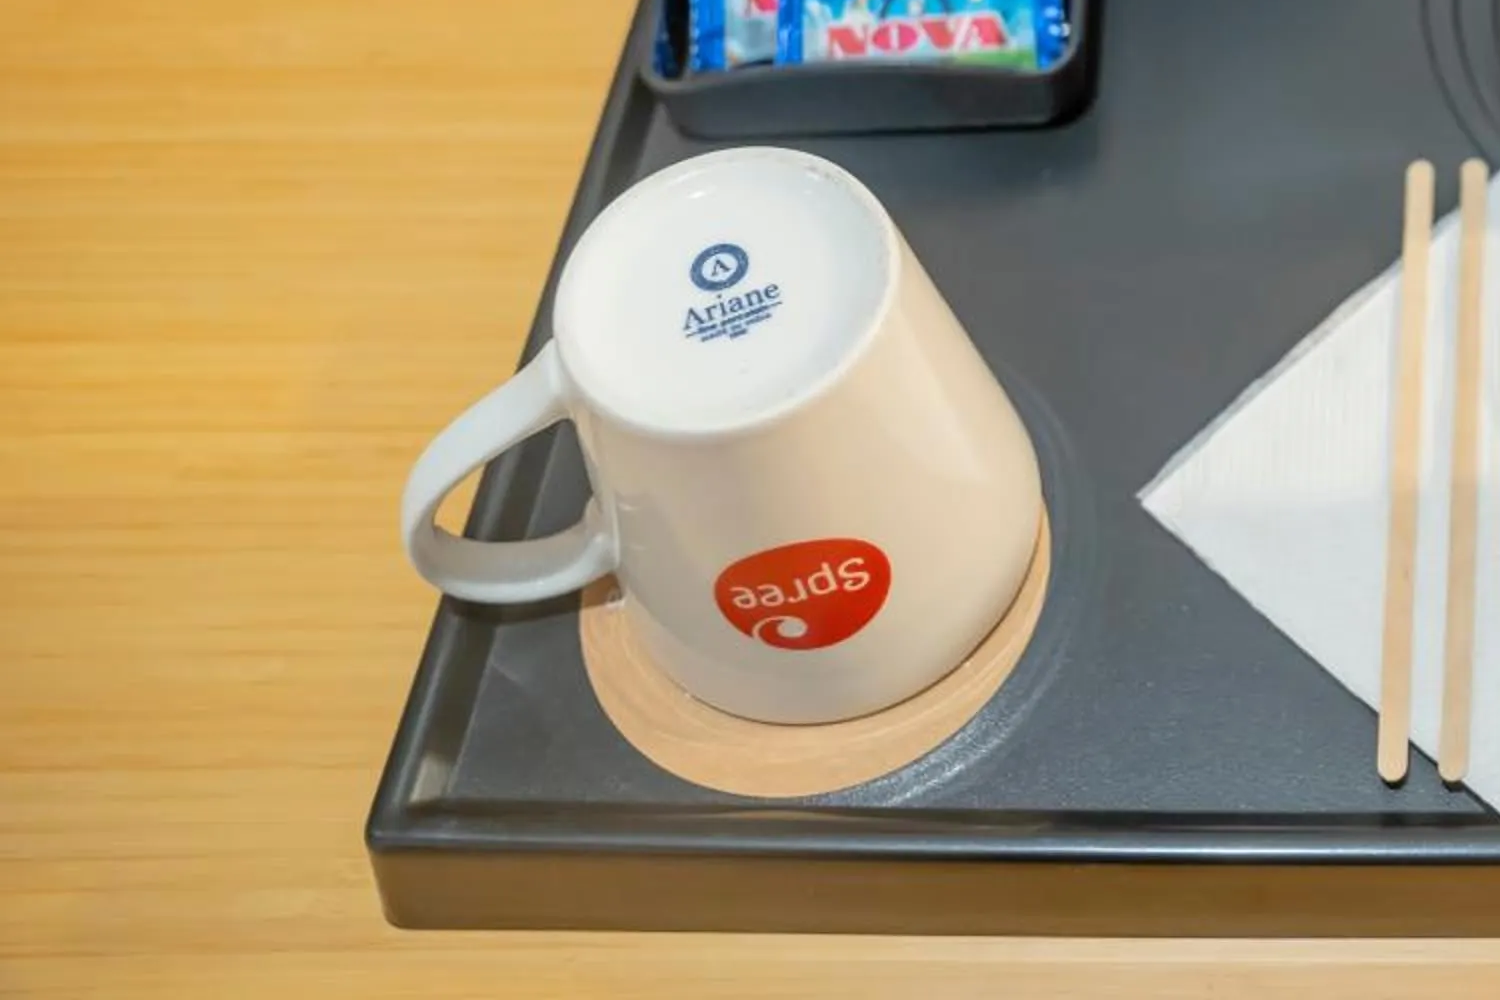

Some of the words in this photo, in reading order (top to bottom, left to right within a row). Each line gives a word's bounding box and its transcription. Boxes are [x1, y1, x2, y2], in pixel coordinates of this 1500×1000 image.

[826, 13, 1007, 56] NOVA
[683, 283, 781, 331] Ariane
[730, 557, 872, 610] Spree
